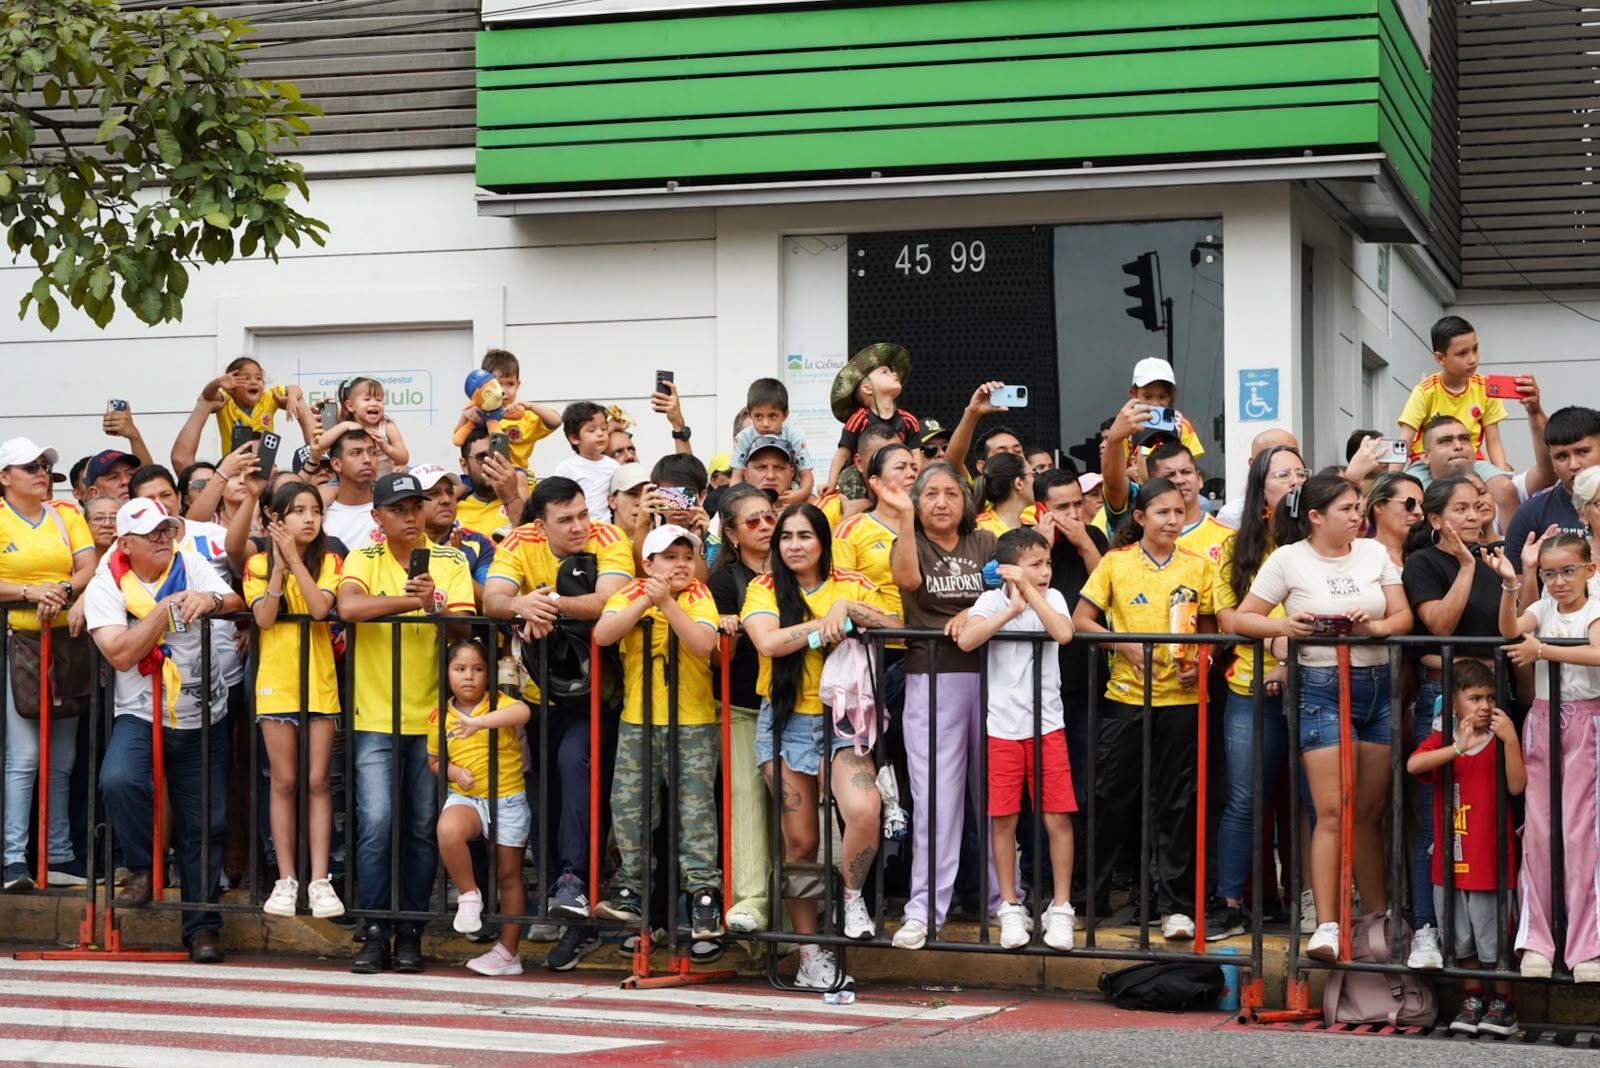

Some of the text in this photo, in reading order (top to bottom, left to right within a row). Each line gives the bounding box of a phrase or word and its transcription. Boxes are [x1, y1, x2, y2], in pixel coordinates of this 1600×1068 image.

[895, 240, 986, 275] 45 99
[926, 573, 983, 593] CALIFORNI
